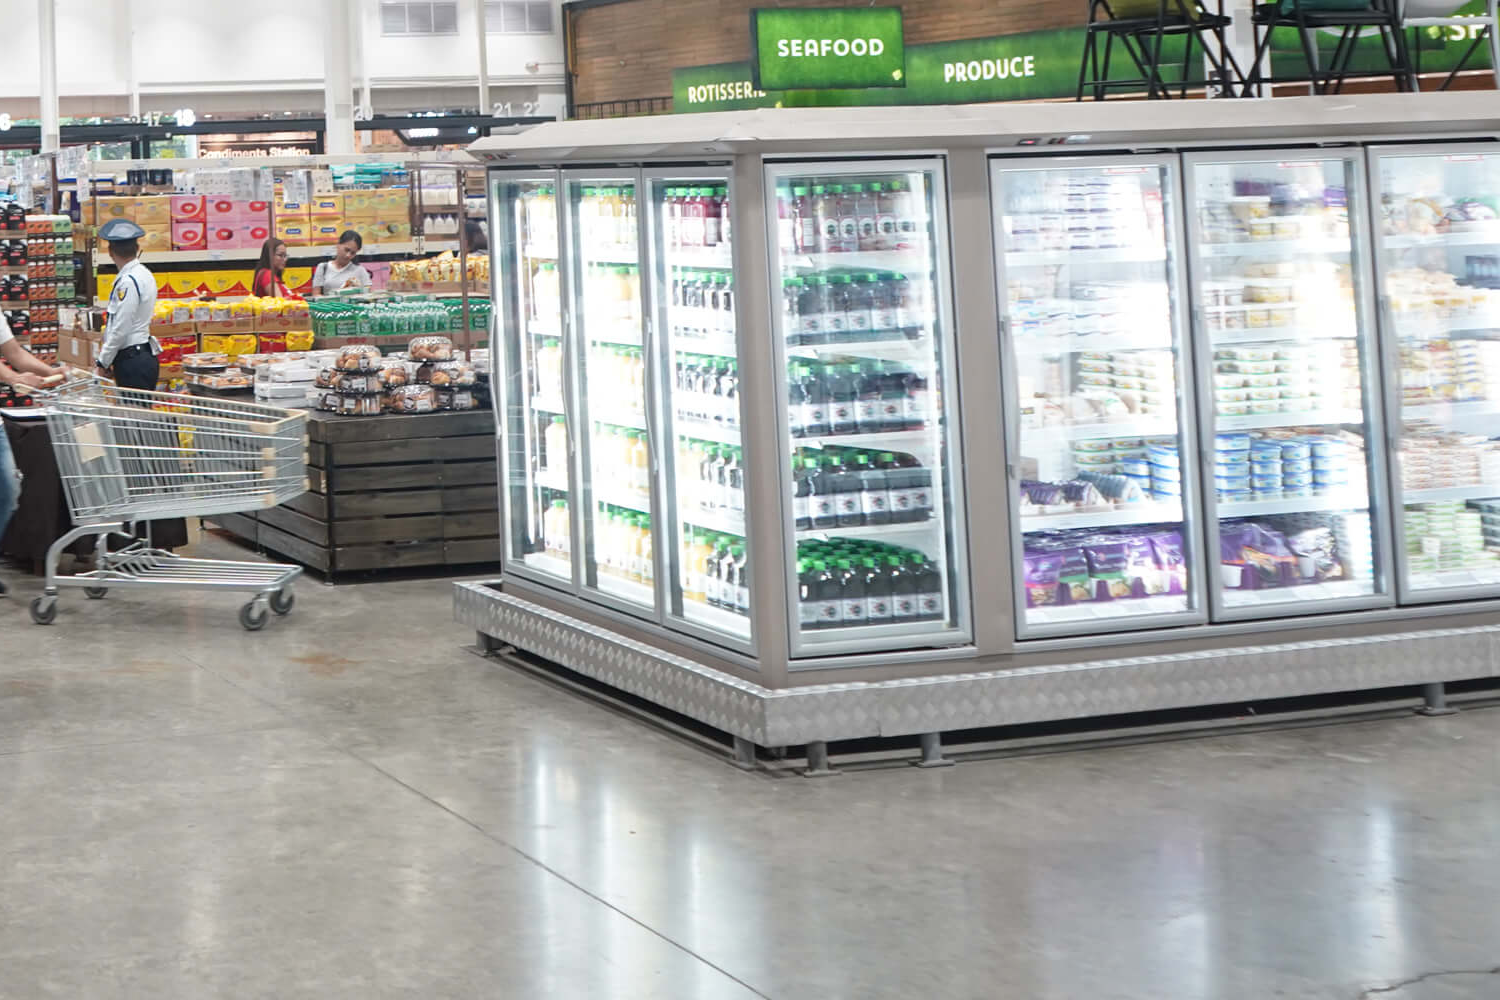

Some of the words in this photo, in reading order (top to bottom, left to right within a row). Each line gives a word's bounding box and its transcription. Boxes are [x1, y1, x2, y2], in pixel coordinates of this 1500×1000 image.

[777, 38, 884, 57] SEAFOOD
[944, 55, 1035, 83] PRODUCE
[493, 102, 513, 117] 21
[199, 147, 267, 160] Condiments
[269, 146, 310, 158] Station
